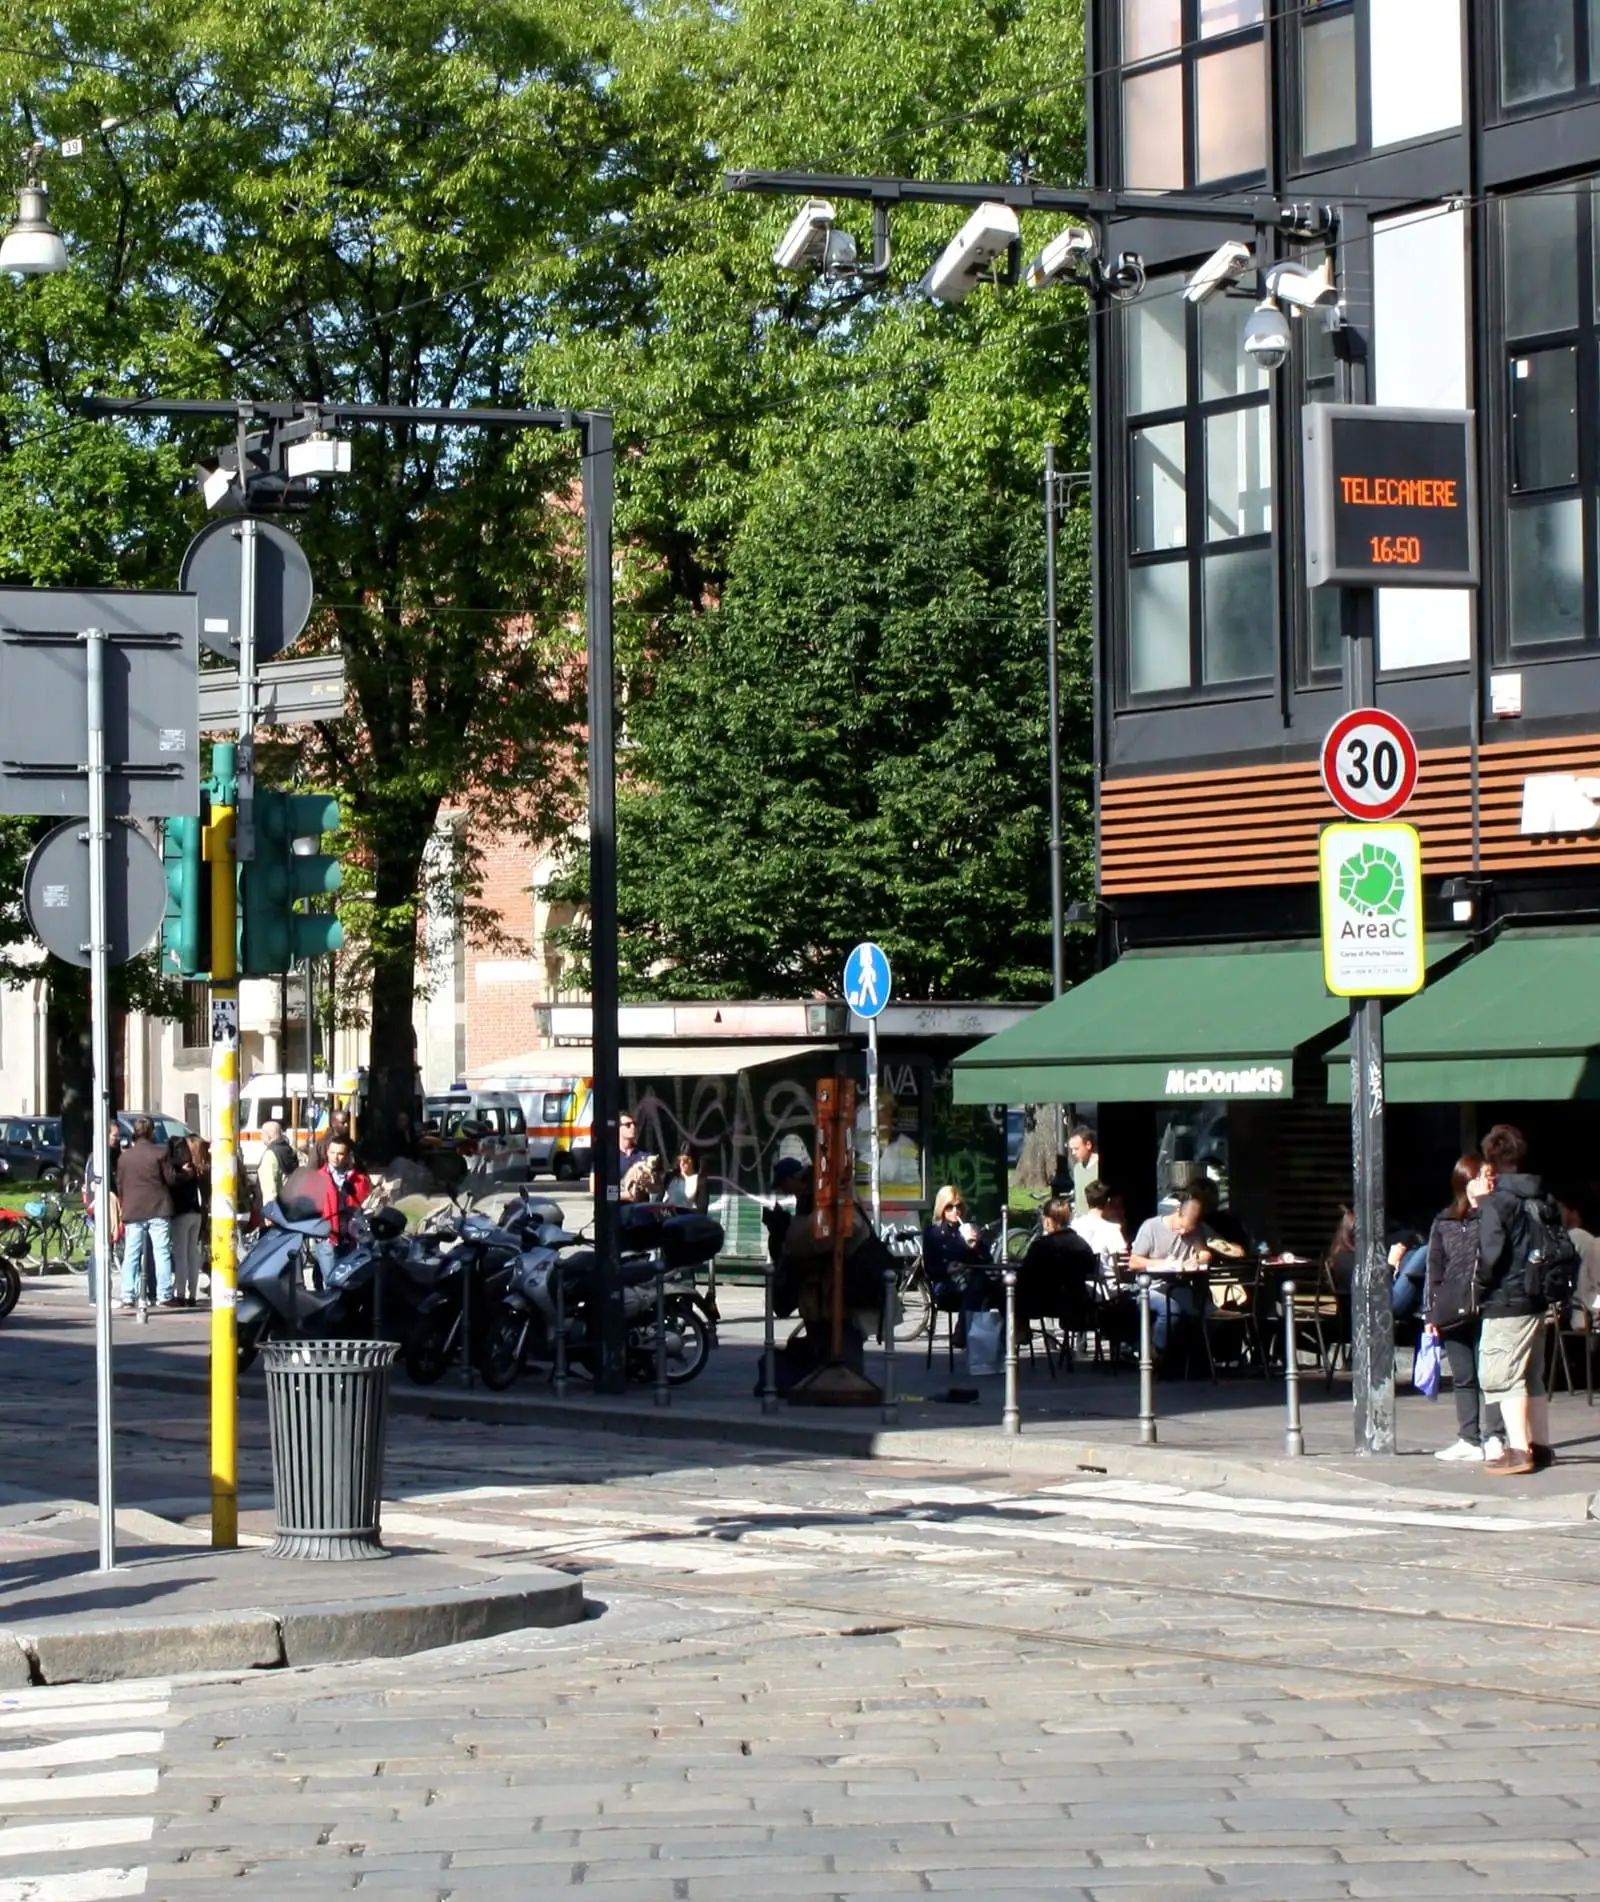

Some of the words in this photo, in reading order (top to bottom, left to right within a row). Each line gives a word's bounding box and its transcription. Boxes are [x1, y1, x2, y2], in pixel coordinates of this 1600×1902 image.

[1340, 477, 1457, 507] TELECAMERE
[1370, 536, 1420, 563] 16:50
[1346, 739, 1398, 790] 30
[1165, 1066, 1283, 1094] McDonald's
